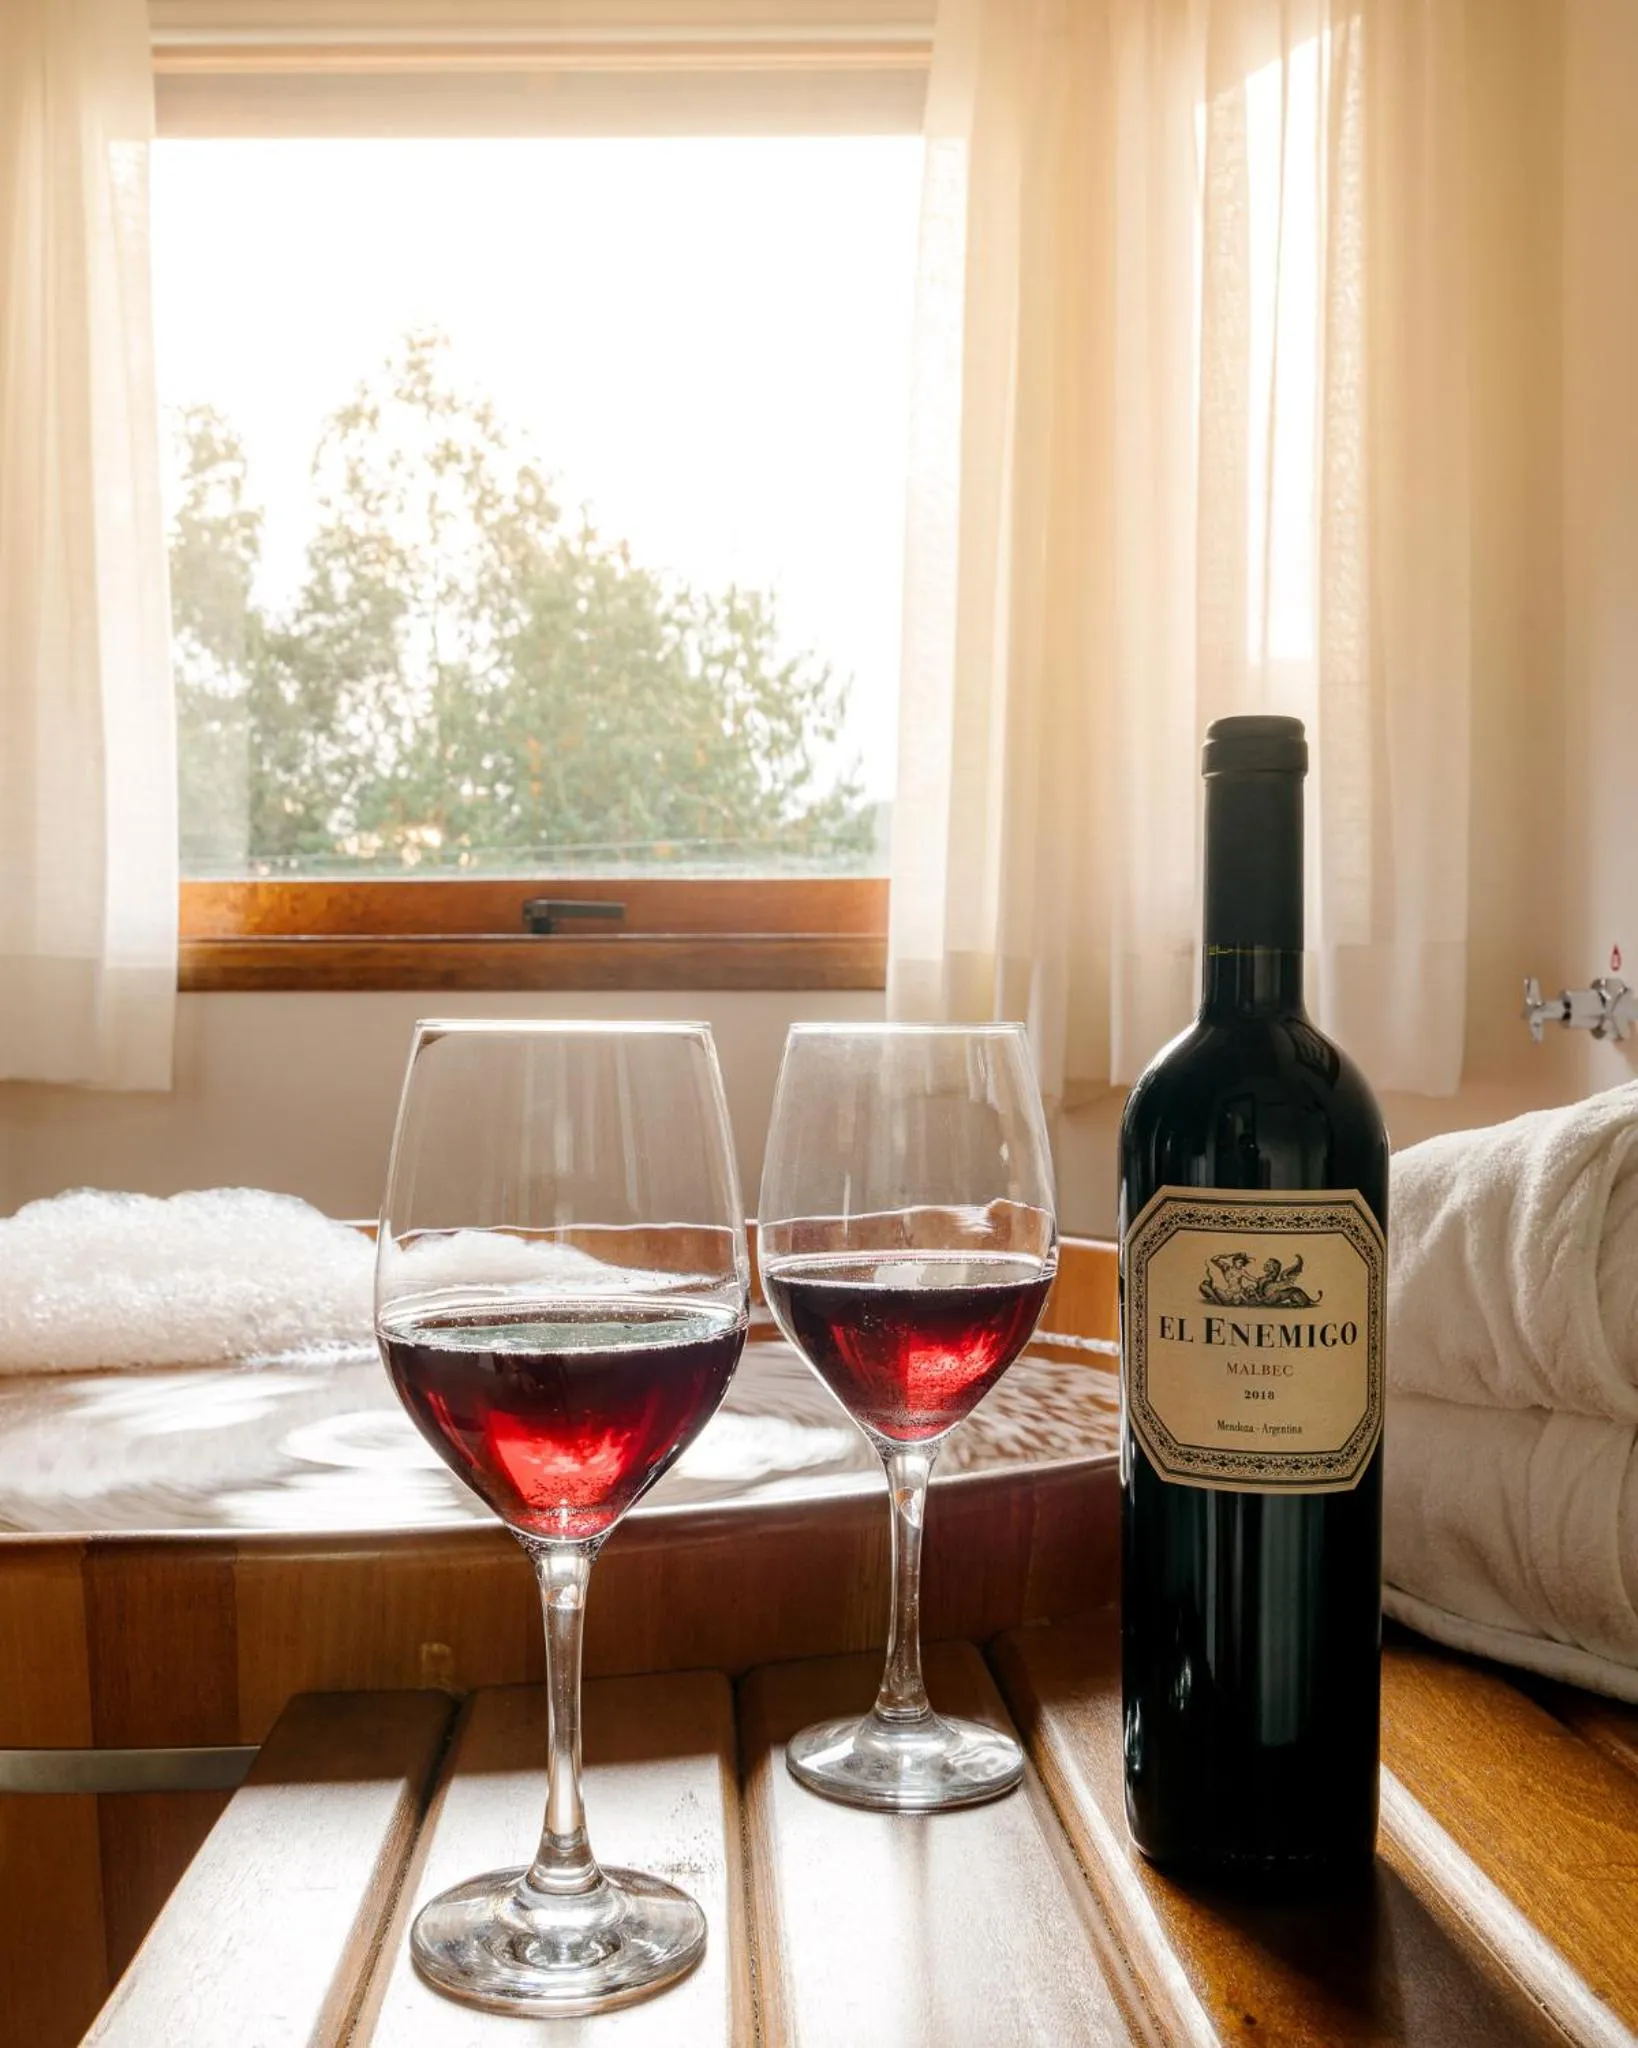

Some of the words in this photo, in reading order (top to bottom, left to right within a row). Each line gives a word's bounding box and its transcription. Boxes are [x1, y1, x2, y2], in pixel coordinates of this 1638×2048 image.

[1159, 1315, 1194, 1343] EL
[1203, 1316, 1358, 1348] ENEMIGO
[1227, 1362, 1294, 1377] MALBEC
[1243, 1389, 1275, 1401] 2018
[1216, 1419, 1255, 1433] Mendoza
[1261, 1423, 1303, 1436] Argentina
